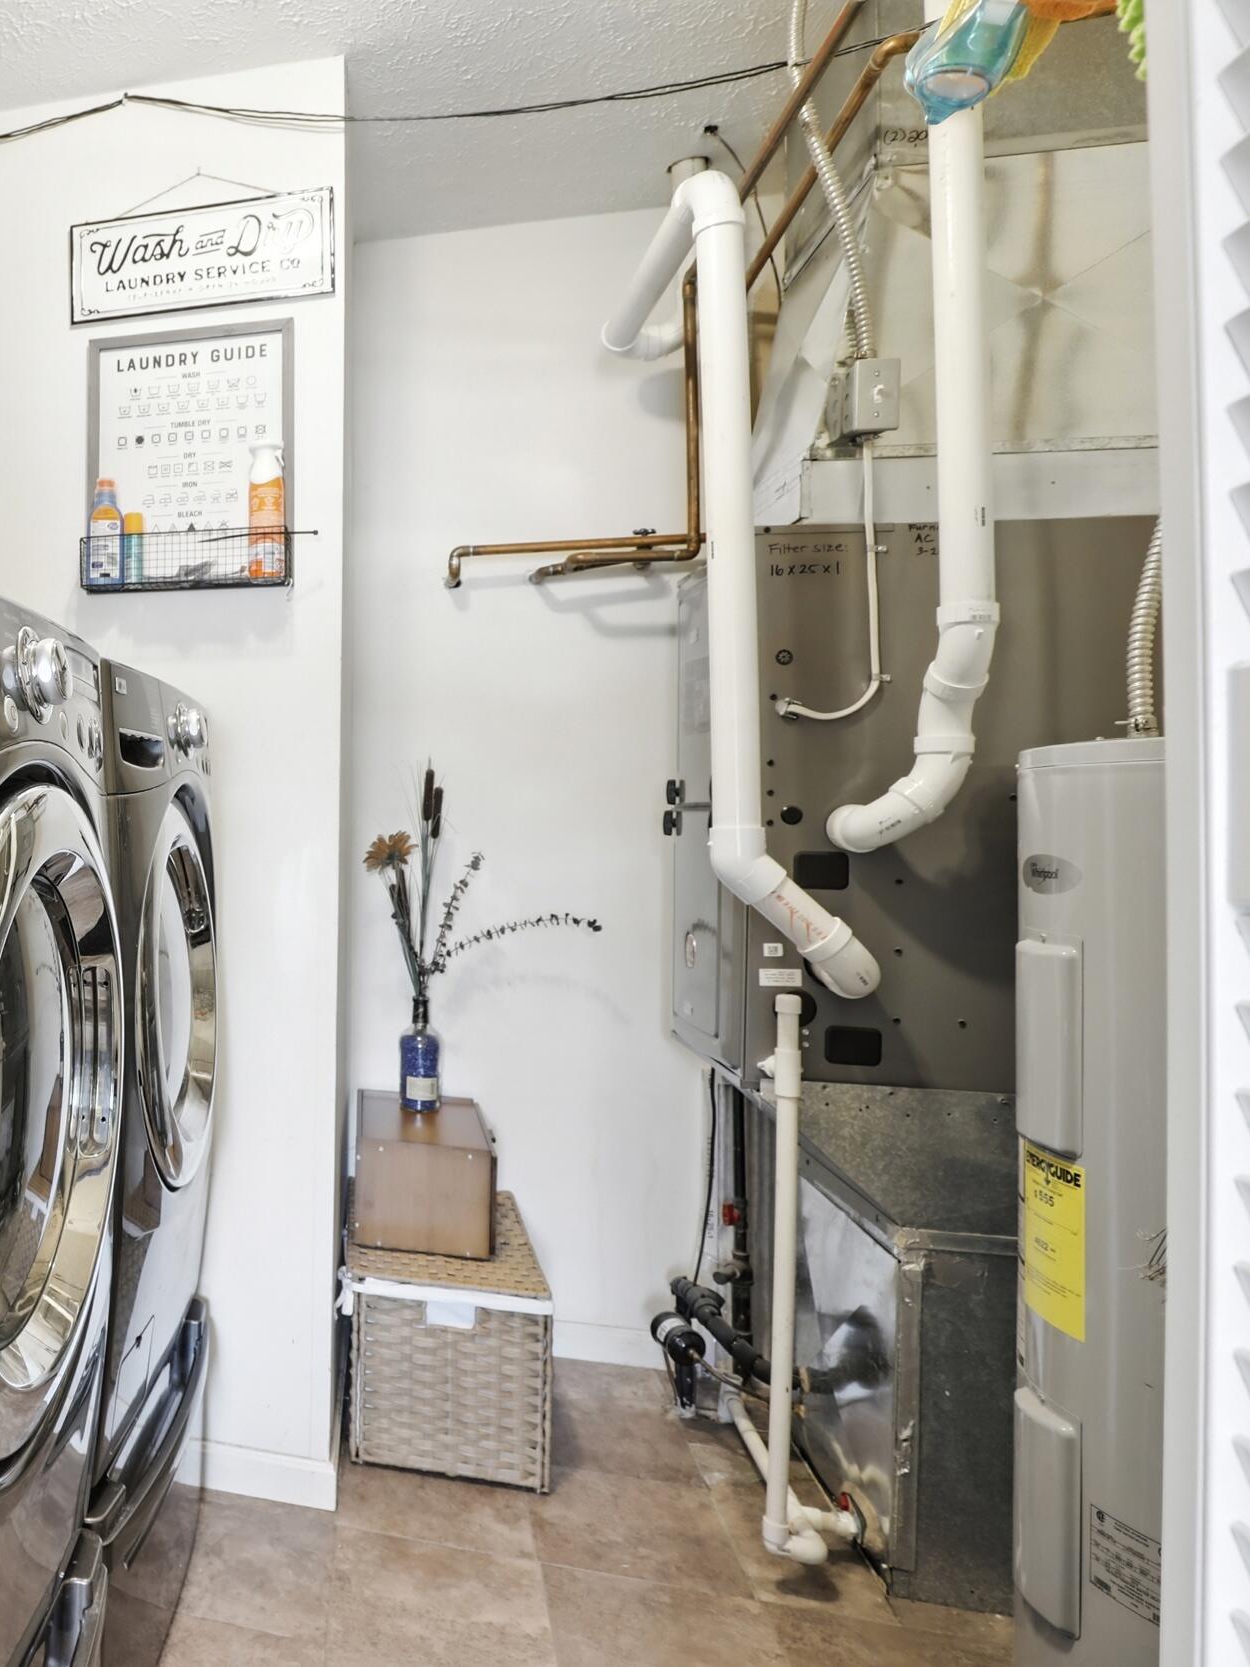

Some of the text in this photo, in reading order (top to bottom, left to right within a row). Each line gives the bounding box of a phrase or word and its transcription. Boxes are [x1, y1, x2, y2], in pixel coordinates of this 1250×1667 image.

[90, 225, 190, 276] Wash
[195, 231, 225, 251] and
[105, 271, 187, 293] LAUNDRY
[194, 260, 271, 281] SERVICE
[117, 344, 268, 372] LAUNDRY GUIDE
[182, 371, 201, 379] WASH
[171, 421, 195, 429] TUMBLE
[177, 510, 203, 518] BLEACH
[915, 534, 934, 544] AC
[768, 543, 806, 556] Filter
